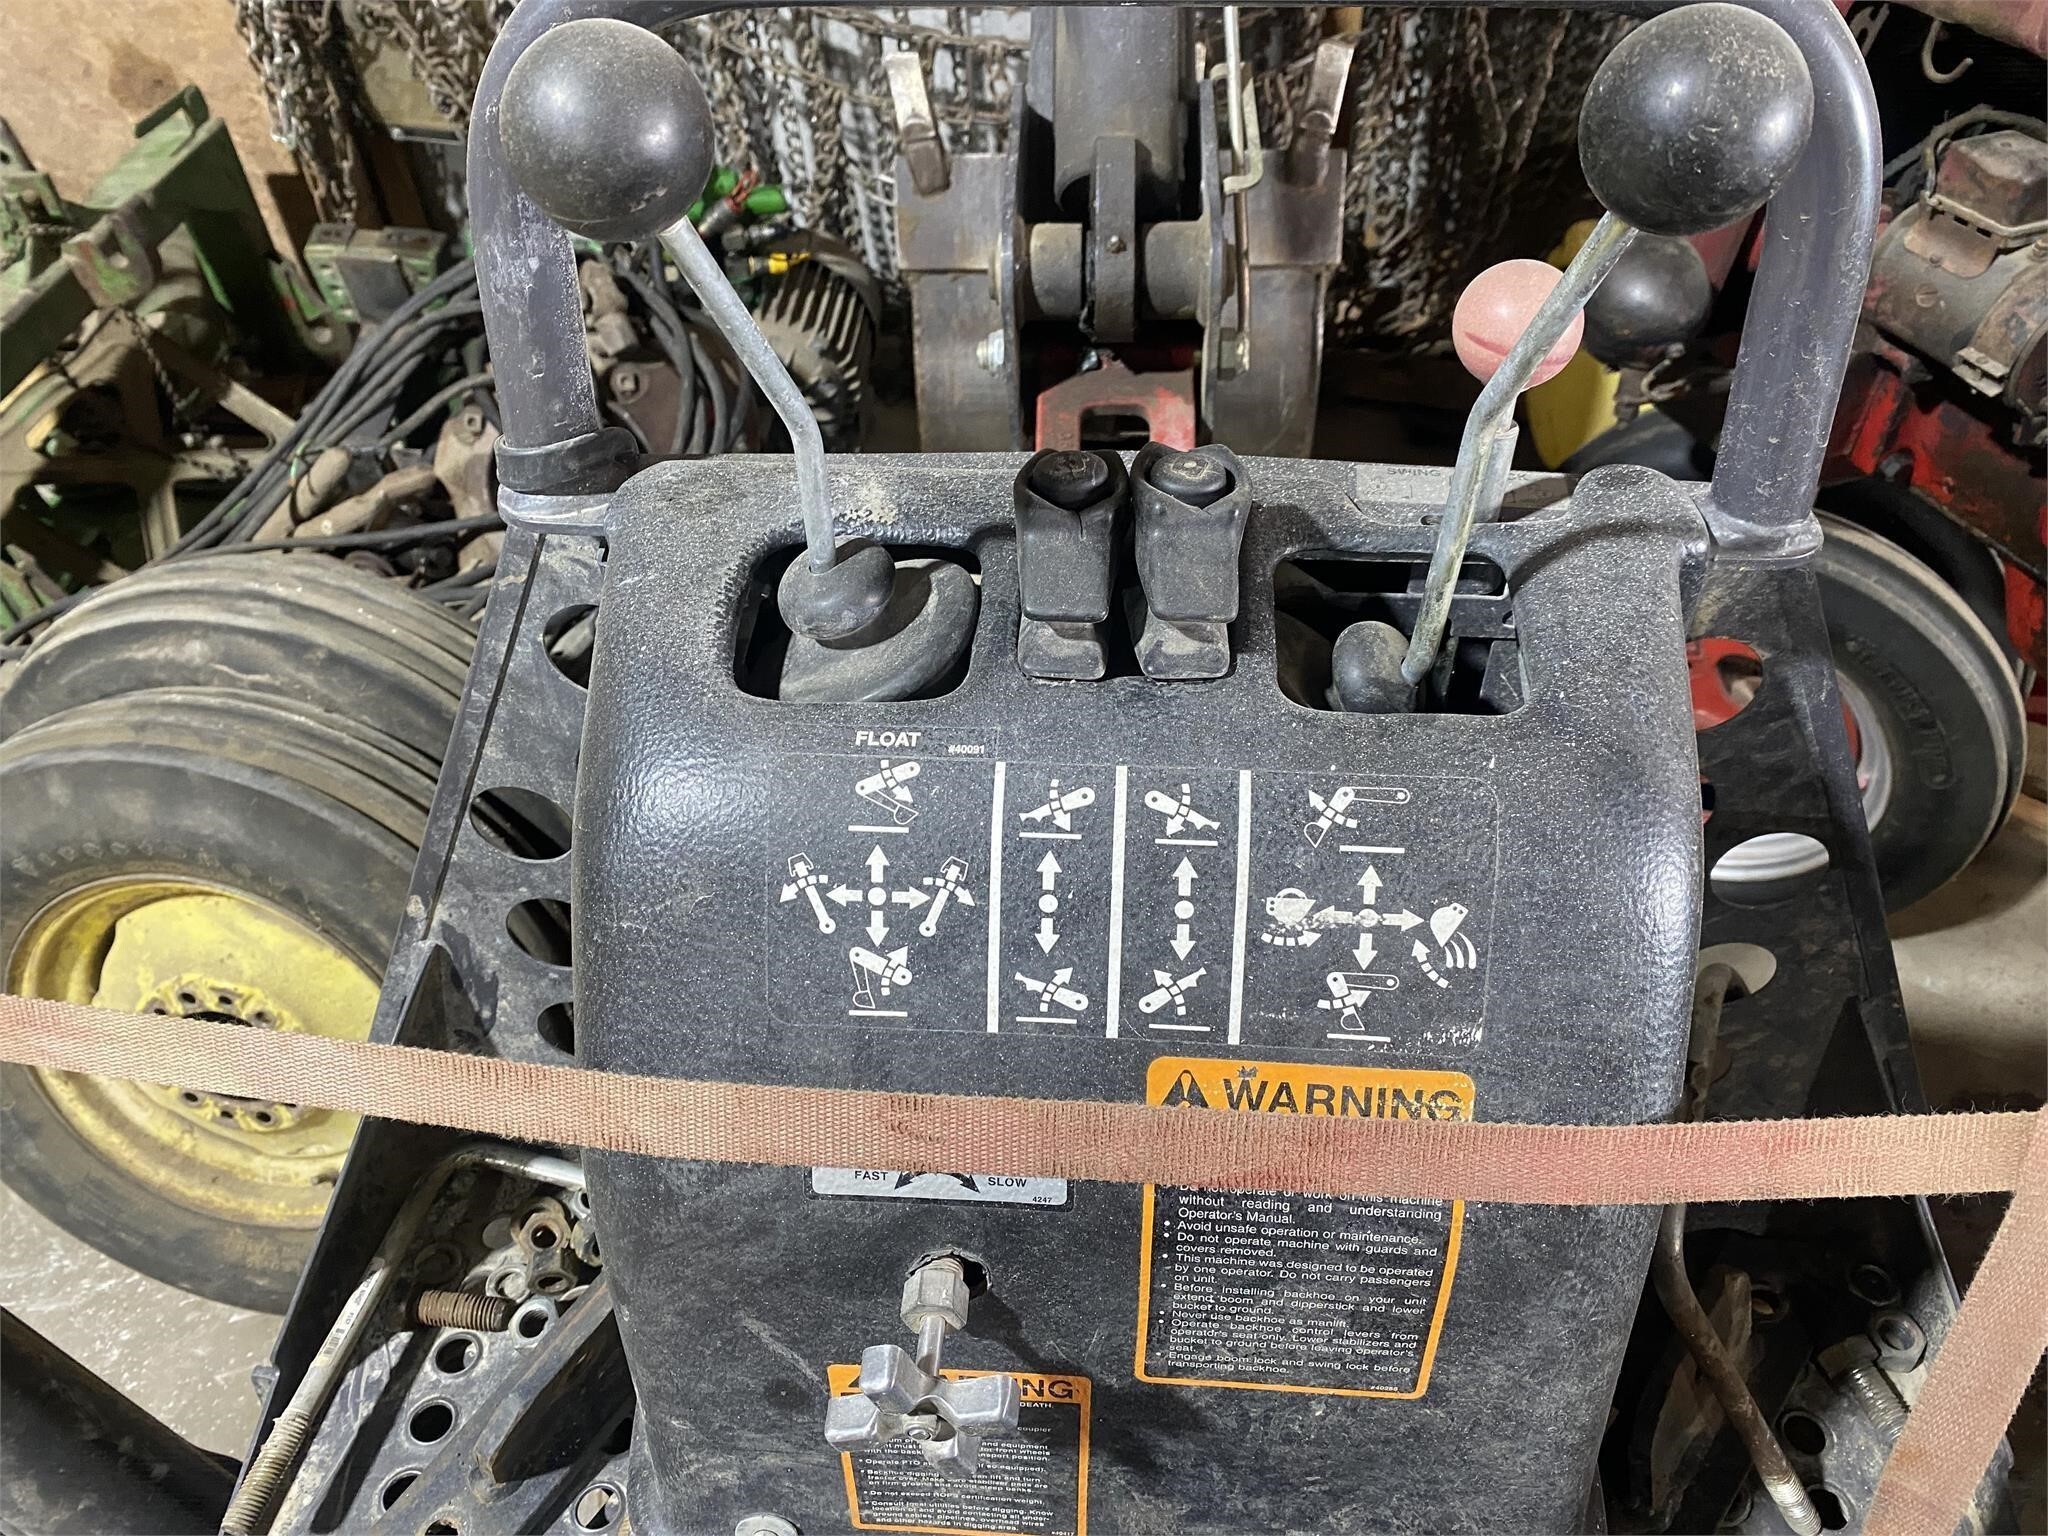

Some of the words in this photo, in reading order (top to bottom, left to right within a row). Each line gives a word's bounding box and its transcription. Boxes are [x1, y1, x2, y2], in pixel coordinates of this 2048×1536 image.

[1387, 467, 1441, 477] SWING
[855, 731, 921, 747] FLOAT
[948, 745, 985, 755] #40091
[1223, 1078, 1462, 1120] WARNING
[854, 1170, 888, 1181] FAST
[987, 1177, 1027, 1187] SLOW
[1178, 1207, 1243, 1221] Operator's
[1246, 1211, 1295, 1224] Manual.
[1179, 1194, 1224, 1207] without
[1242, 1199, 1290, 1213] reading
[1307, 1202, 1332, 1214] and
[1350, 1205, 1442, 1221] understanding
[1177, 1220, 1212, 1231] Avoid
[1215, 1223, 1257, 1234] unsafe
[1261, 1226, 1319, 1238] operation
[1322, 1231, 1336, 1239] or
[1340, 1231, 1421, 1244] maintenance.
[1176, 1244, 1216, 1254] covers
[1220, 1246, 1276, 1257] removed.
[1177, 1232, 1194, 1242] Do
[1200, 1235, 1219, 1244] not
[1224, 1236, 1271, 1247] operate
[1277, 1239, 1330, 1250] machine
[1335, 1242, 1360, 1252] with
[1365, 1245, 1408, 1255] guards
[1414, 1247, 1438, 1257] and
[1176, 1253, 1200, 1263] This
[1204, 1255, 1255, 1266] machine
[1259, 1260, 1283, 1269] was
[1286, 1260, 1343, 1272] designed
[1346, 1263, 1357, 1272] to
[1360, 1264, 1376, 1275] be
[1378, 1266, 1434, 1278] operated
[1174, 1263, 1189, 1274] by
[1193, 1265, 1216, 1274] one
[1220, 1267, 1274, 1278] operator.
[1280, 1269, 1297, 1279] Do
[1301, 1271, 1321, 1280] not
[1325, 1273, 1356, 1284] carry
[1360, 1276, 1431, 1288] passengers
[1193, 1274, 1218, 1284] unit.
[1173, 1293, 1213, 1302] extend
[1220, 1294, 1254, 1304] boom
[1261, 1298, 1284, 1307] and
[1291, 1299, 1355, 1311] dipperstick
[1362, 1304, 1386, 1313] and
[1392, 1306, 1425, 1315] lower
[1284, 1290, 1336, 1301] backhoe
[1344, 1294, 1360, 1302] on
[1369, 1295, 1396, 1304] your
[1404, 1297, 1428, 1306] unit
[1172, 1301, 1211, 1311] bucket
[1215, 1303, 1226, 1312] to
[1230, 1305, 1274, 1315] ground.
[1172, 1310, 1207, 1319] Never
[1210, 1312, 1232, 1321] use
[1235, 1313, 1285, 1324] backhoe
[1307, 1319, 1349, 1329] manlift.
[1170, 1328, 1228, 1338] operator's
[1232, 1331, 1258, 1340] seat
[1261, 1333, 1287, 1342] only.
[1293, 1334, 1330, 1344] Lower
[1332, 1338, 1390, 1348] stabilizers
[1394, 1341, 1417, 1349] and
[1171, 1319, 1220, 1329] Operate
[1230, 1322, 1282, 1333] backhoe
[1292, 1326, 1334, 1336] control
[1344, 1329, 1381, 1339] levers
[1391, 1332, 1419, 1341] from
[1170, 1336, 1208, 1345] bucket
[1211, 1338, 1222, 1346] to
[1226, 1340, 1267, 1349] ground
[1270, 1341, 1308, 1351] before
[1311, 1344, 1352, 1355] leaving
[1356, 1347, 1414, 1357] operator's
[1170, 1344, 1196, 1352] seat.
[1168, 1360, 1234, 1371] transporting
[1238, 1364, 1290, 1374] backhoe.
[1169, 1352, 1212, 1361] Engage
[1217, 1353, 1249, 1363] boom
[1254, 1356, 1277, 1365] lock
[1282, 1359, 1304, 1367] and
[1308, 1360, 1341, 1370] swing
[1346, 1362, 1369, 1371] lock
[1374, 1364, 1411, 1374] before
[1001, 1442, 1049, 1450] equipment
[865, 1458, 900, 1467] Operate
